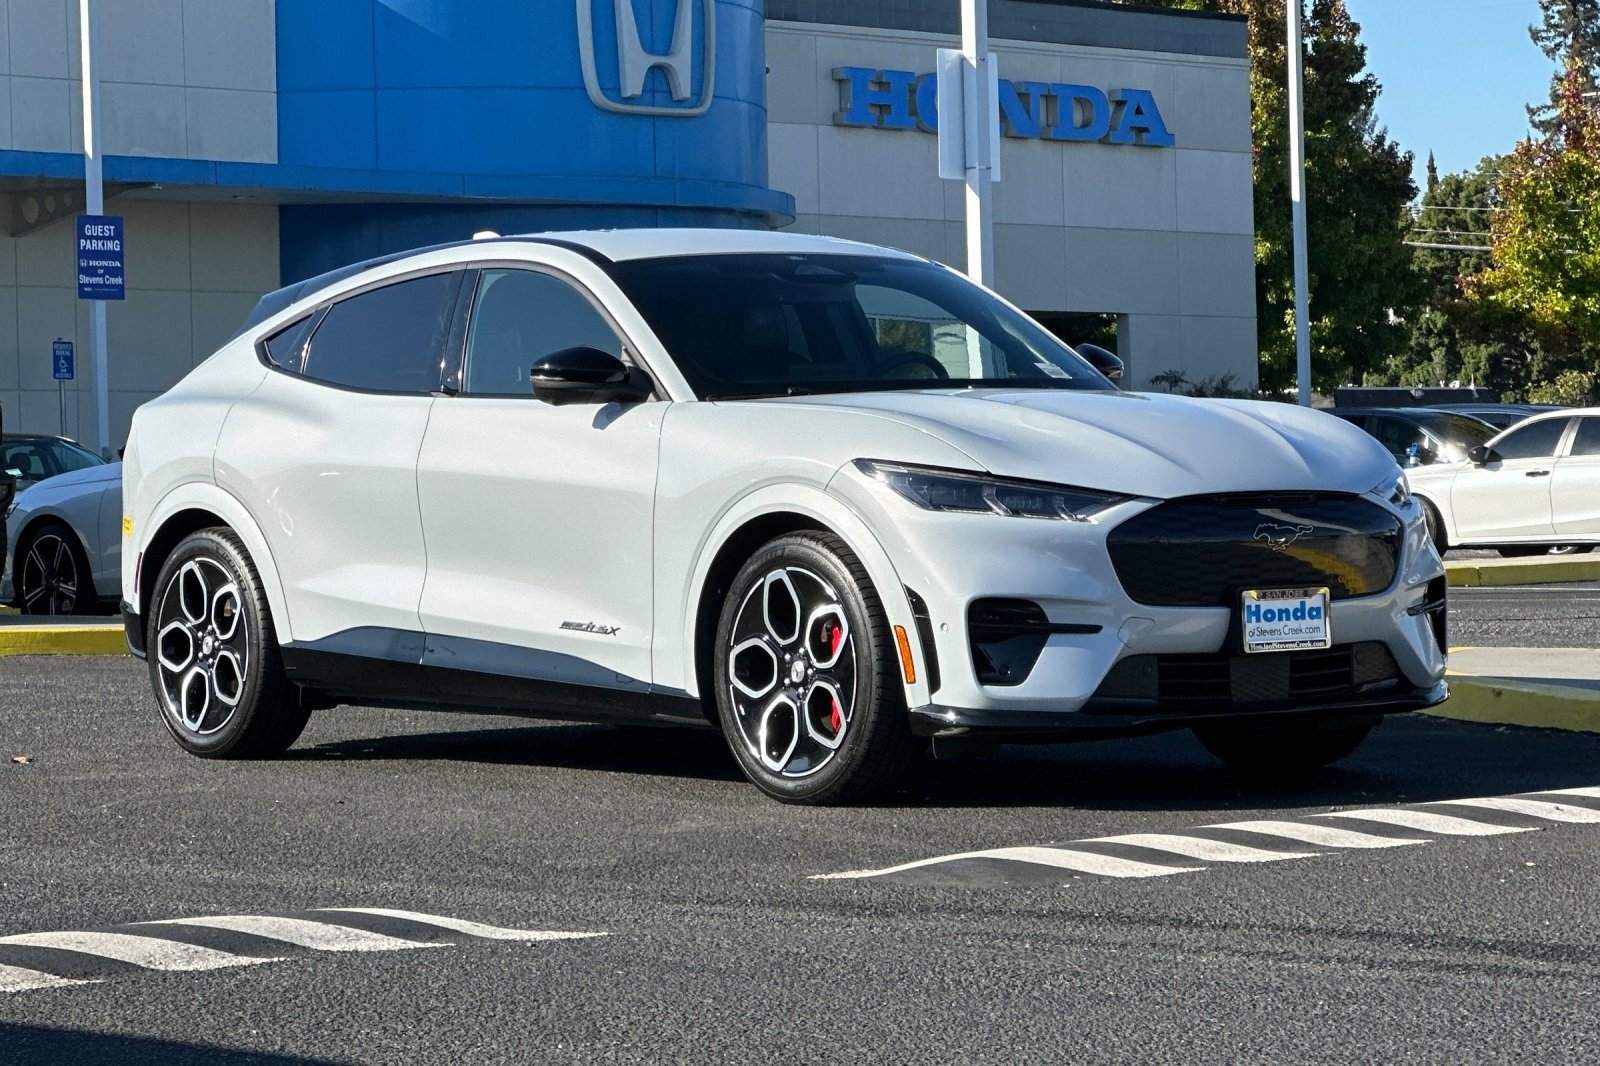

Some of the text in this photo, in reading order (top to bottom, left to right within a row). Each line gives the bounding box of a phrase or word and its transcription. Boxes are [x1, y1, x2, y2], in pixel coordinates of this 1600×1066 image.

[84, 224, 115, 237] GUEST
[80, 239, 121, 251] PARKING
[79, 274, 123, 285] Stevens Creek
[1265, 590, 1304, 599] SAN JOSE
[1246, 601, 1321, 623] Honda
[1248, 623, 1321, 638] of Stevens Creek.com
